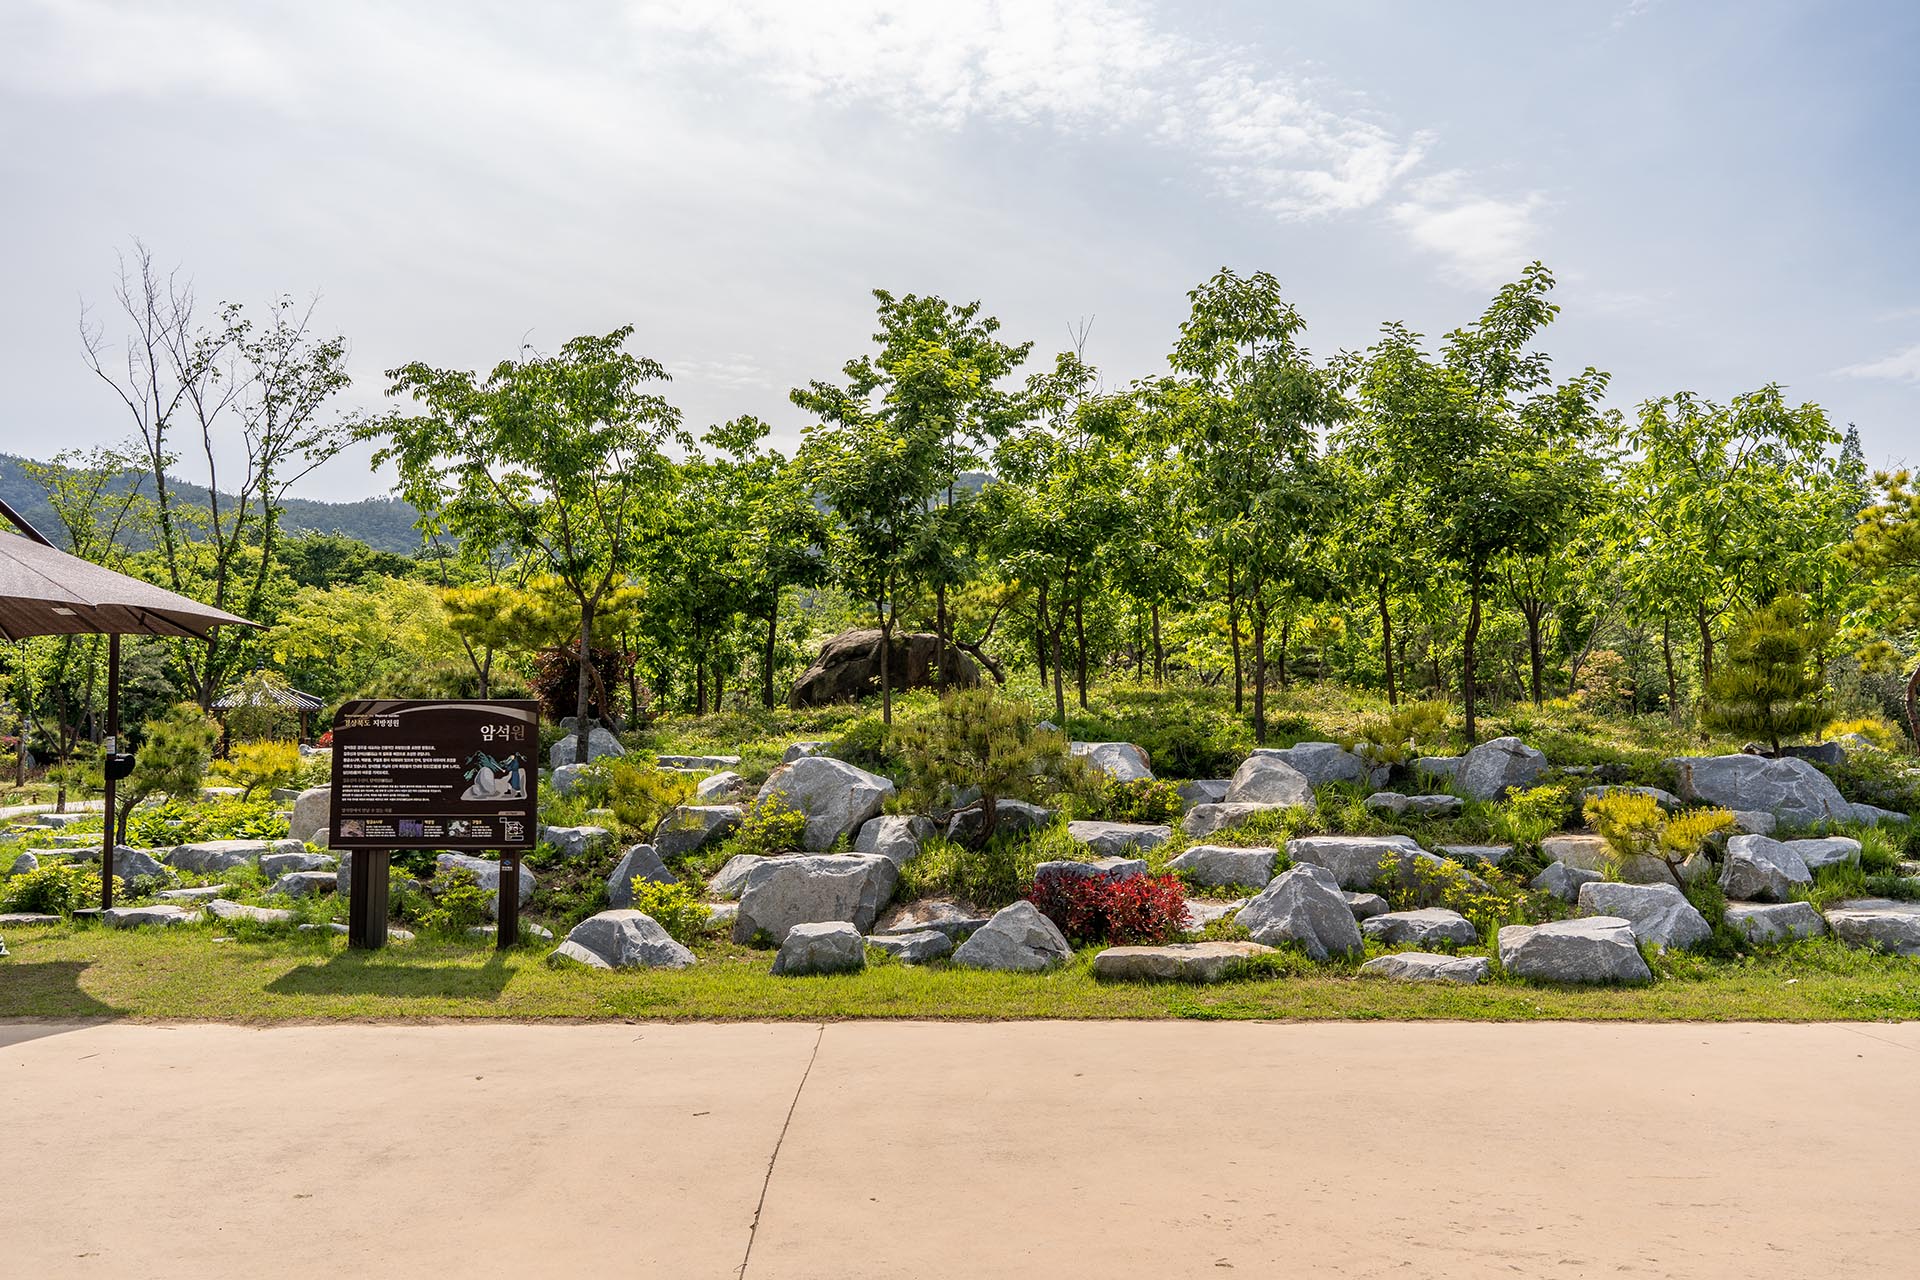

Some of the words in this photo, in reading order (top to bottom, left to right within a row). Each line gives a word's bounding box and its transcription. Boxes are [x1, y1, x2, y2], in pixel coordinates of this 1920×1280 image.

[344, 719, 371, 728] 경상북도
[373, 719, 400, 728] 지방정원
[480, 724, 525, 742] 암석원
